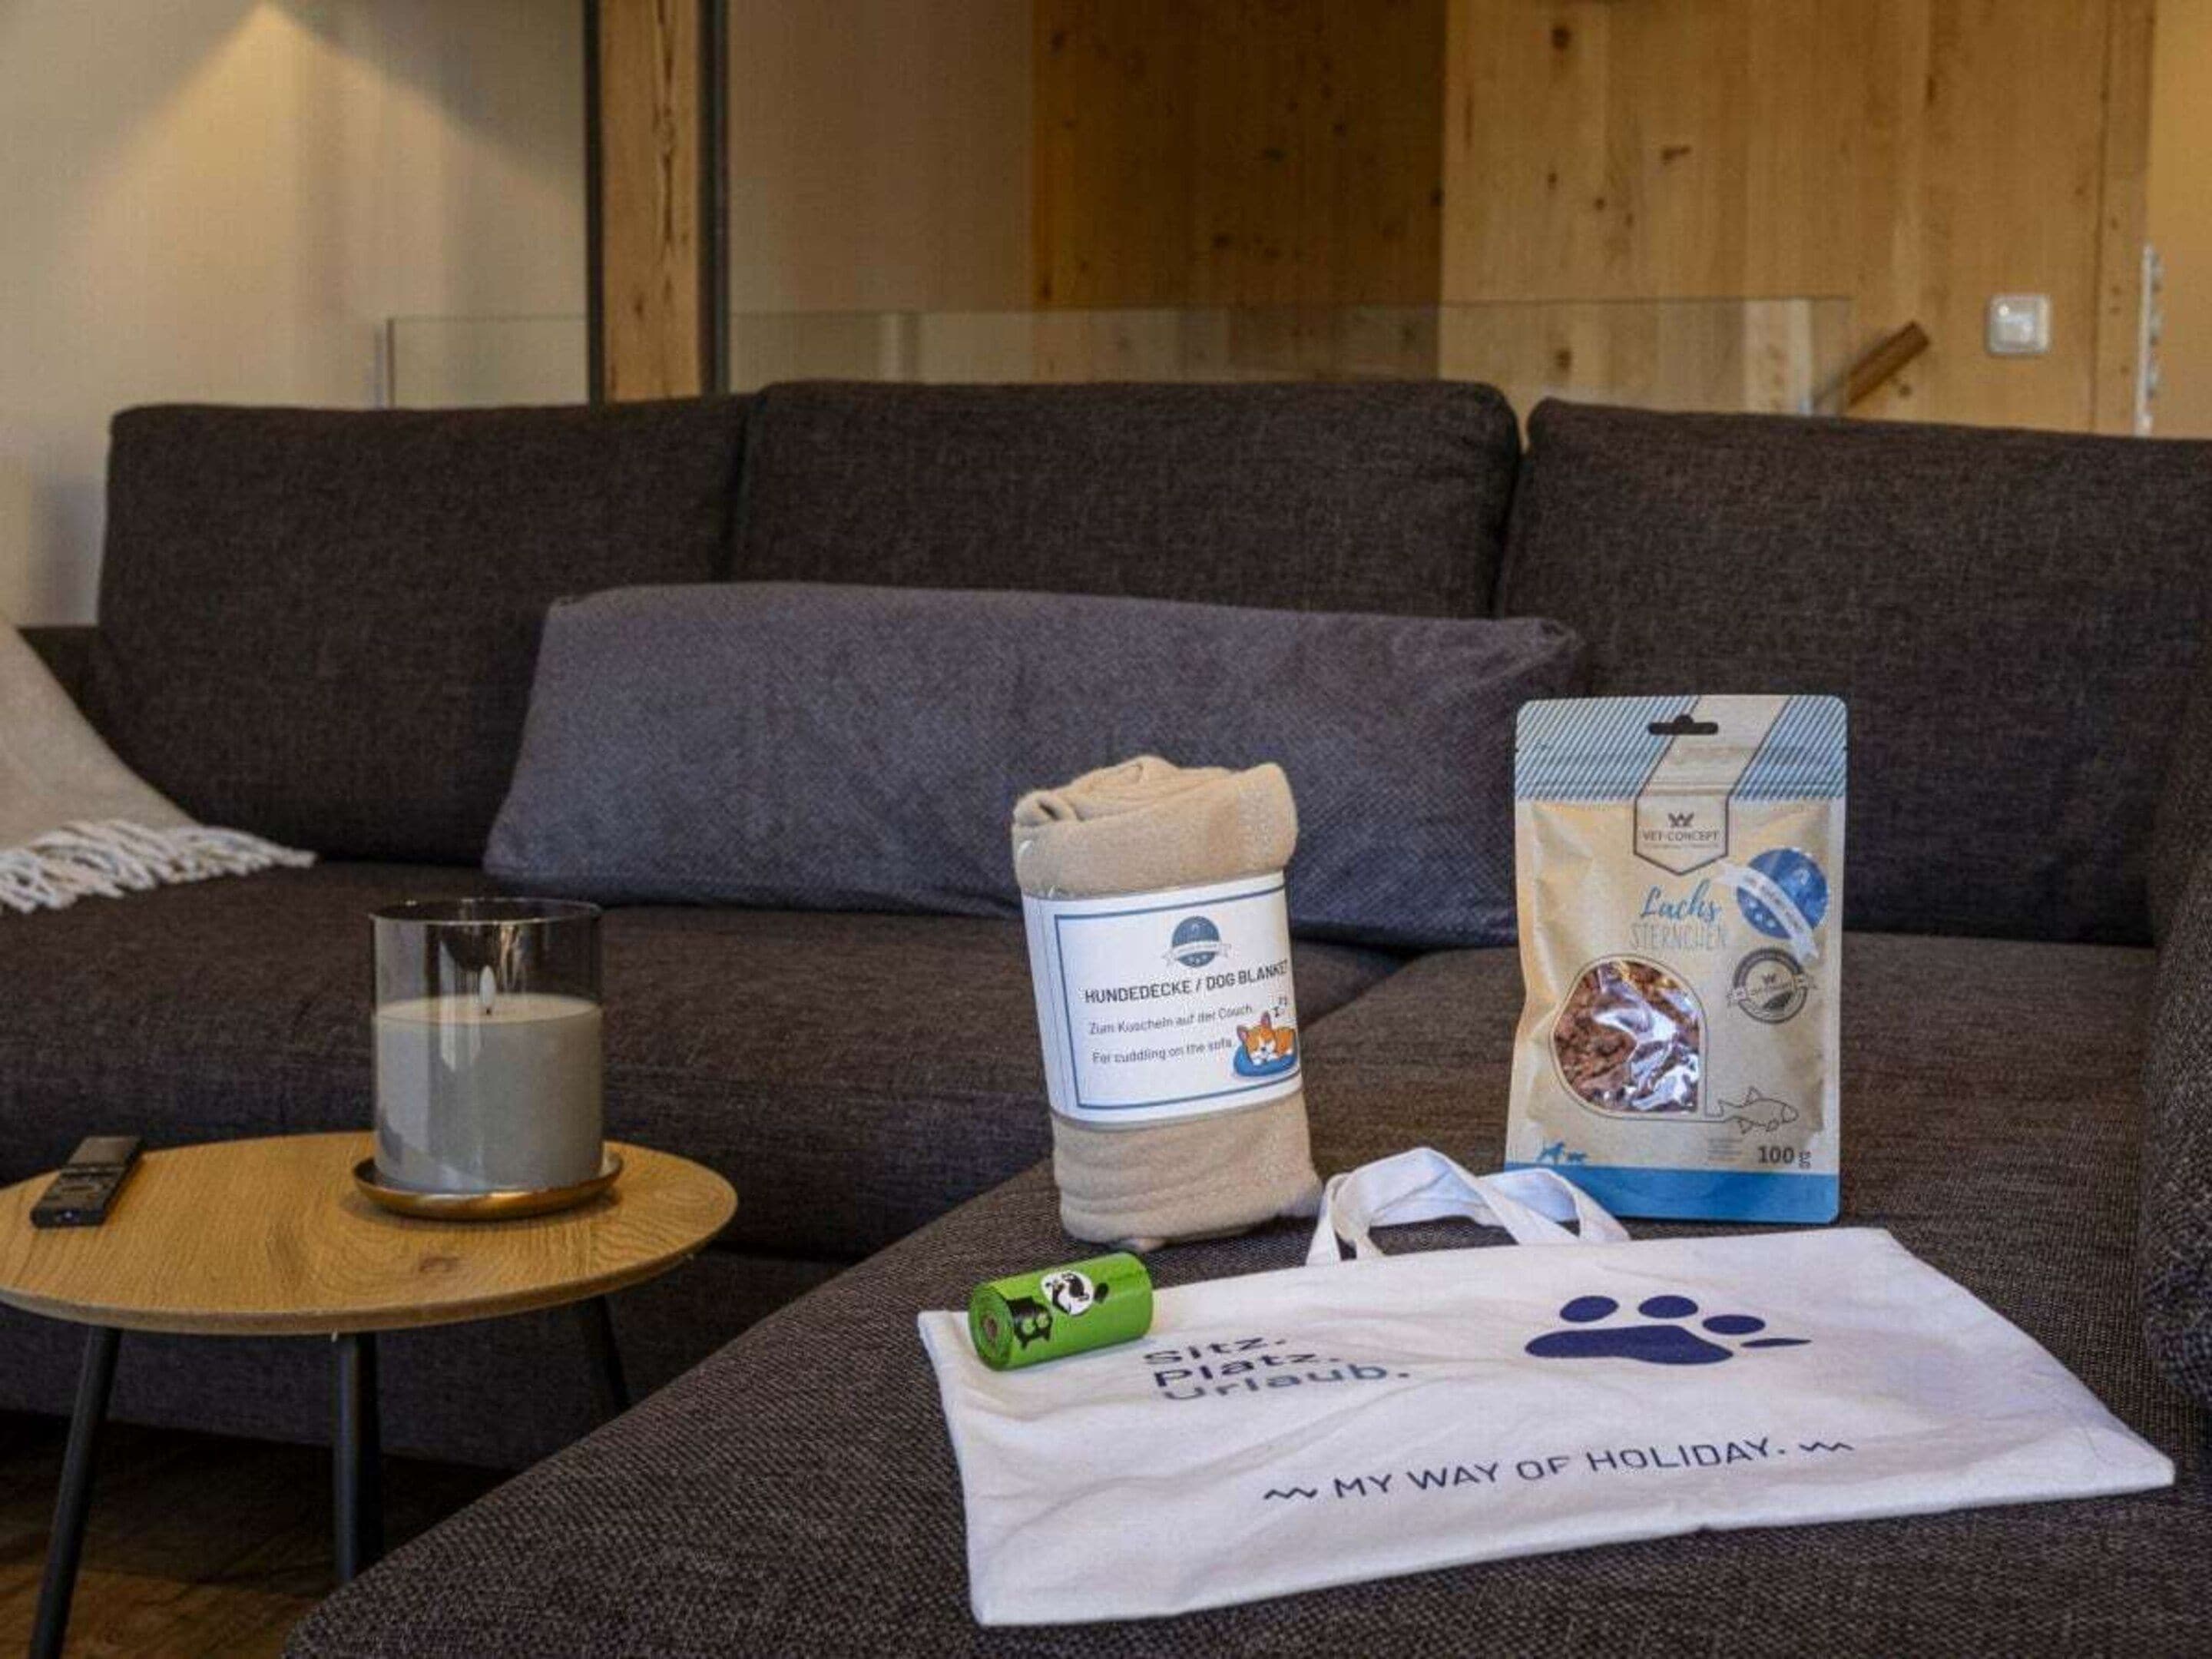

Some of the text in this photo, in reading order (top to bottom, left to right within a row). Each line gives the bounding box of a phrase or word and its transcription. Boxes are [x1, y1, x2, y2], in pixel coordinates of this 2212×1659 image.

[1084, 979, 1191, 1004] HUNDEDECKE
[1195, 979, 1202, 993] /
[1206, 972, 1236, 991] DOG
[1088, 1020, 1114, 1036] Zum
[1118, 1013, 1174, 1034] Kuscheln
[1176, 1014, 1195, 1027] auf
[1197, 1011, 1216, 1024] der
[1218, 1003, 1253, 1021] Couch
[1092, 1050, 1111, 1065] For
[1114, 1045, 1166, 1065] cuddling
[1168, 1046, 1184, 1058] on
[1185, 1041, 1205, 1055] the
[1758, 1146, 1795, 1164] 100
[1798, 1151, 1812, 1168] g
[1143, 1337, 1286, 1365] Sitz.
[1154, 1353, 1341, 1387] Platz.
[1164, 1363, 1410, 1401] Urlaub.
[1333, 1437, 1786, 1498] MY WAY OF HOLIDAY.
